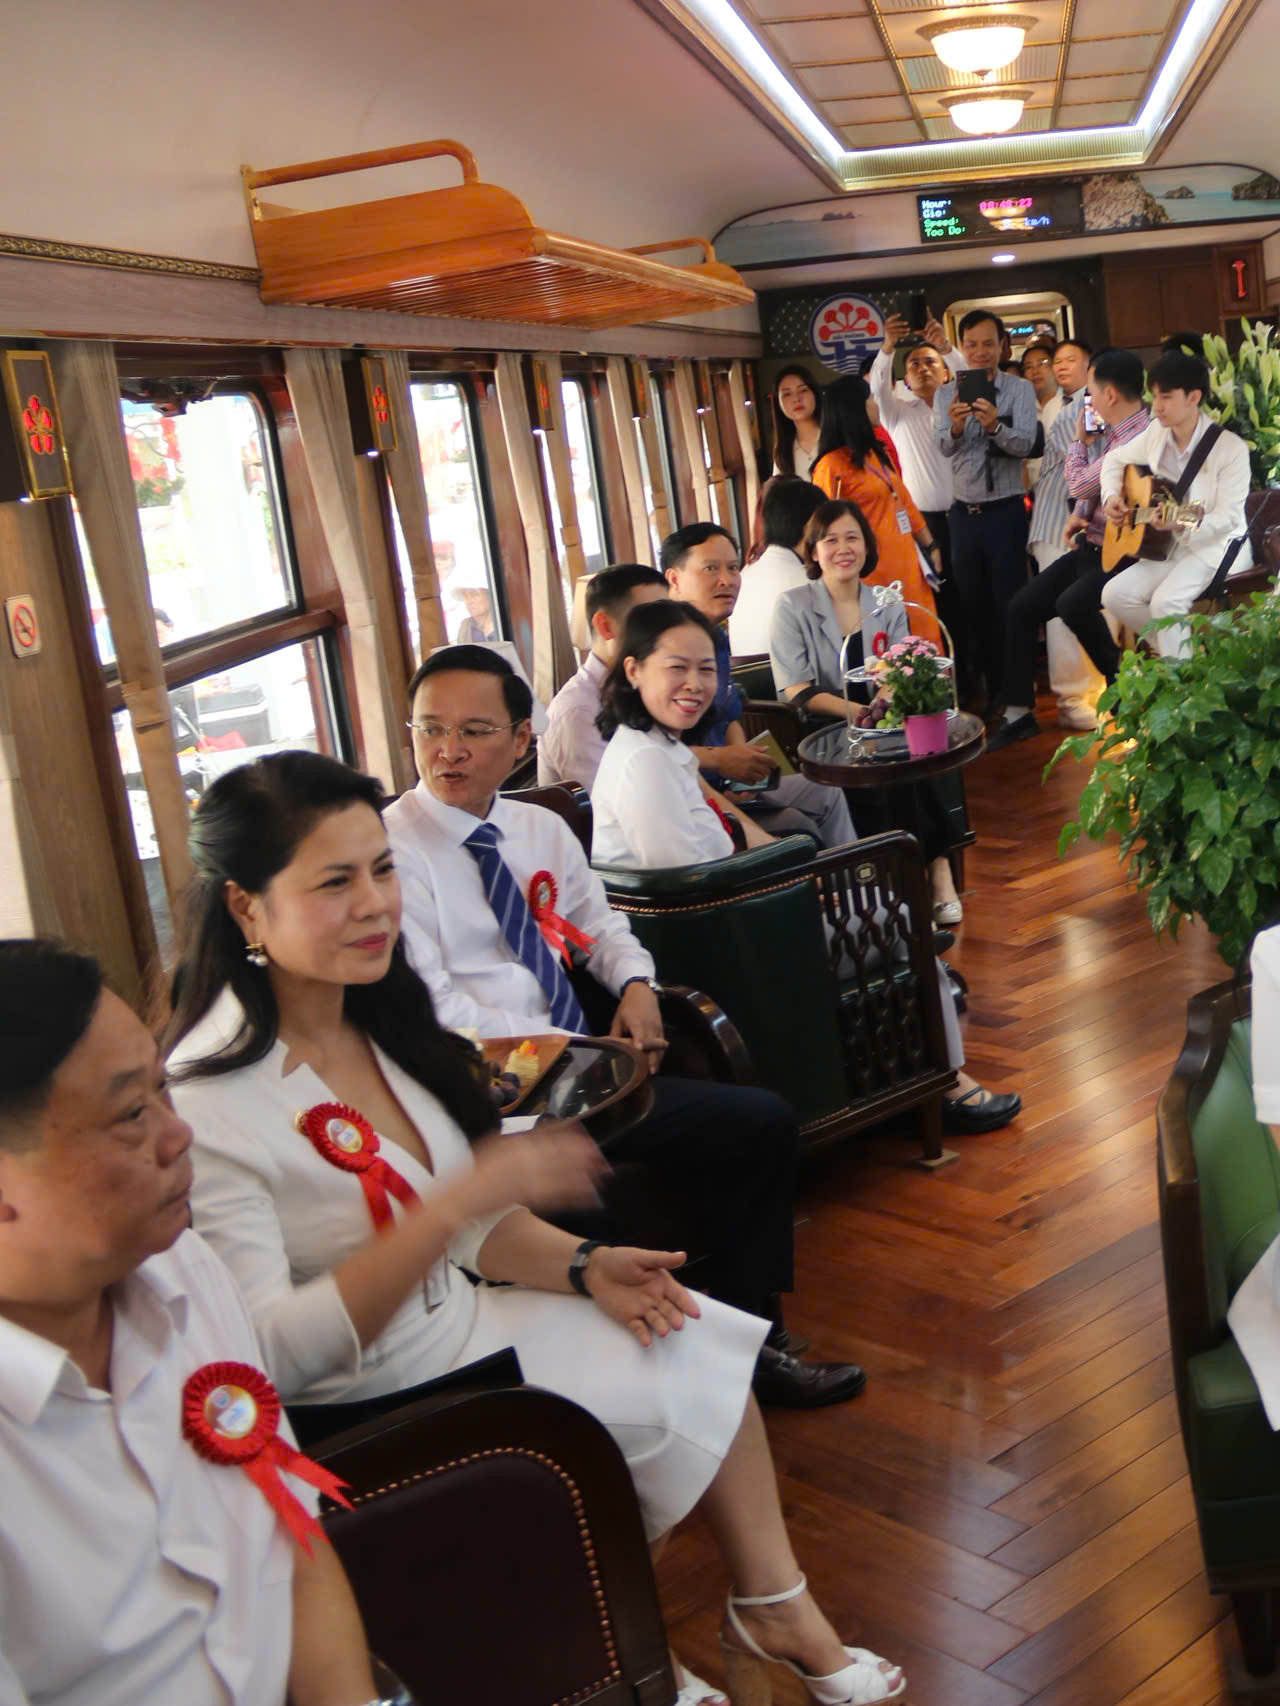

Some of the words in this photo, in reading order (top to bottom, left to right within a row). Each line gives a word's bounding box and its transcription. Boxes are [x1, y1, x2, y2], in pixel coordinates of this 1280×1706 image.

[922, 199, 952, 209] Hour:
[922, 209, 946, 219] Gio:
[924, 216, 960, 230] Speed:
